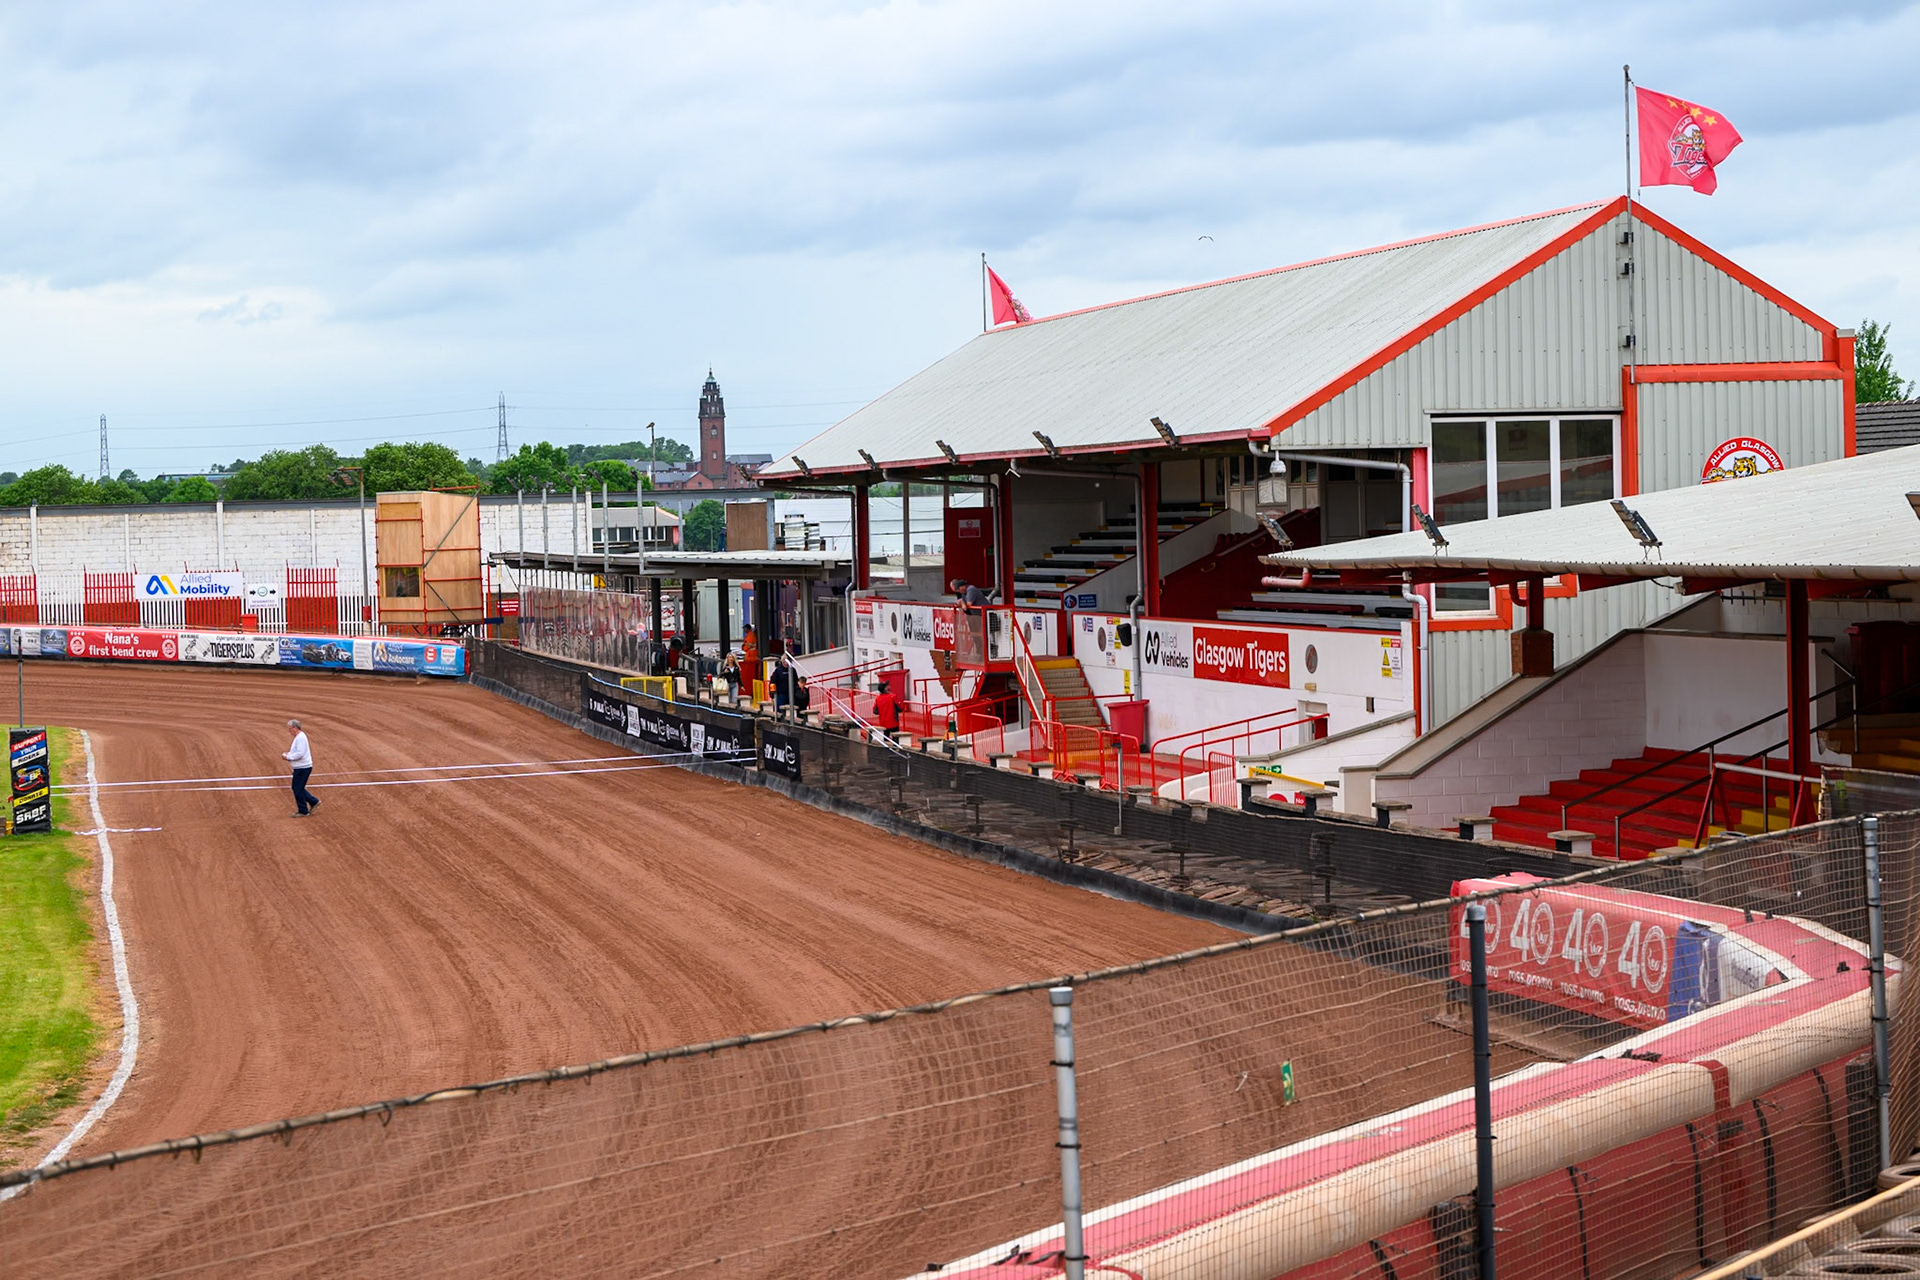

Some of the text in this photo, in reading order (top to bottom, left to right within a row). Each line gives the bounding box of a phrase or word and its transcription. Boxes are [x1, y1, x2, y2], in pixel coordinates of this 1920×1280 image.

[1710, 440, 1780, 468] ALLIED GLASGOW
[180, 574, 212, 583] Allied
[180, 584, 230, 595] Mobility
[105, 633, 140, 645] Nana's
[913, 628, 931, 642] Vehicles
[1160, 631, 1178, 649] Allied
[88, 645, 159, 658] first bend crew
[210, 642, 255, 659] TIGERSPLUS
[1195, 637, 1286, 677] Glasgow Tigers
[388, 653, 415, 664] Autocare
[1160, 650, 1189, 669] Vehicles
[14, 734, 42, 751] SUPPORT
[20, 744, 37, 755] YOUR
[18, 752, 40, 763] RIDERS
[19, 790, 43, 803] DONATE
[1508, 968, 1553, 990] ross.promo
[1560, 982, 1605, 1004] ross.promo
[1614, 995, 1666, 1021] ross.promo
